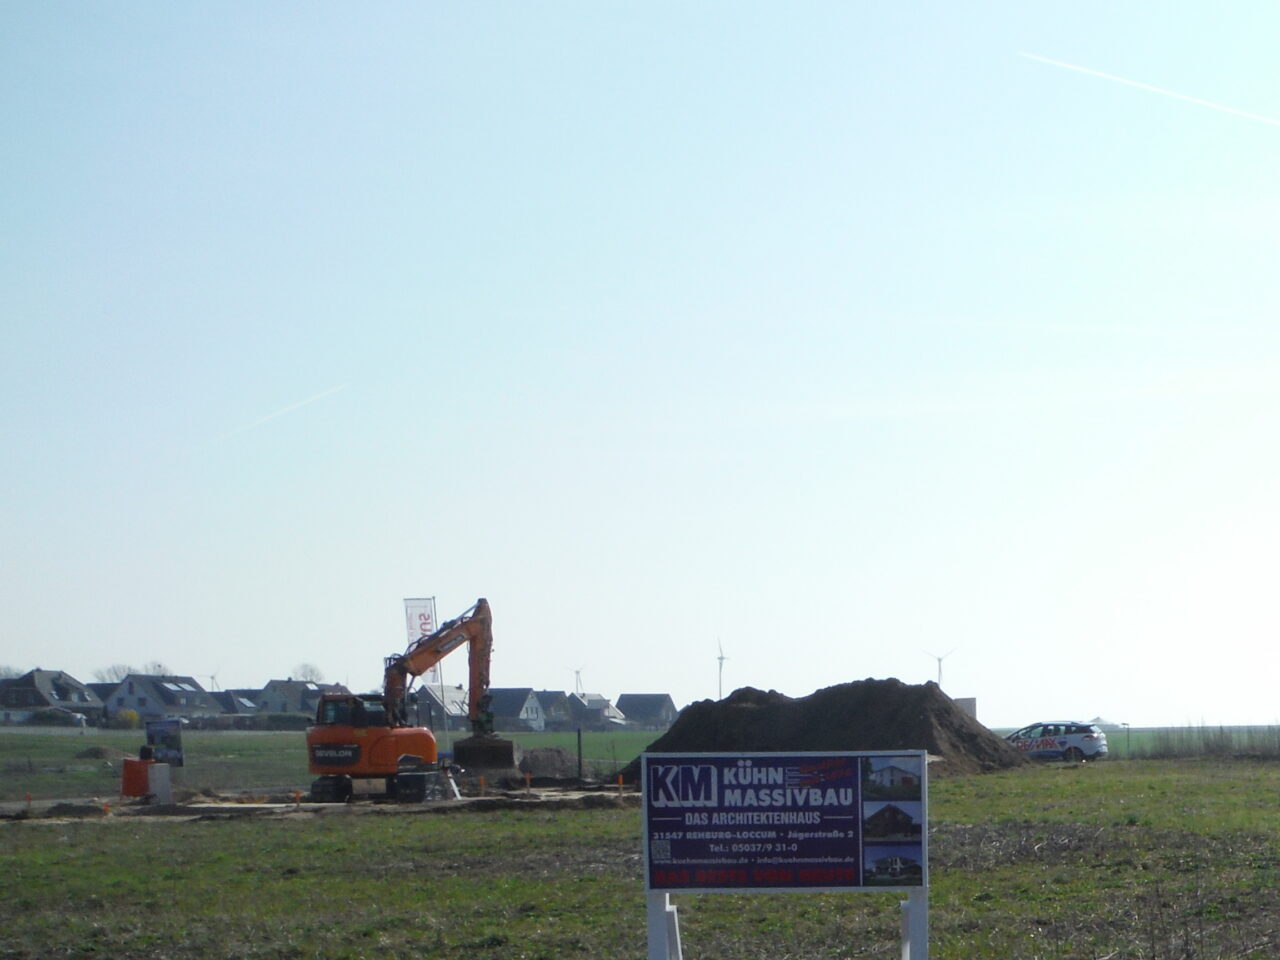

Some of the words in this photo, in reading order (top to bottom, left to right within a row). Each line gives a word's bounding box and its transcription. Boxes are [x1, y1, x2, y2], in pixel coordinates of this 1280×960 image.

[1016, 736, 1059, 752] RE/MAX
[722, 760, 784, 786] KÜHN
[651, 764, 719, 808] KM
[723, 788, 853, 807] MASSIVBAU
[685, 812, 709, 826] DAS
[712, 811, 821, 825] ARCHITEKTENHAUS
[653, 832, 684, 840] 31547
[686, 831, 777, 839] REHBURG-LOCCUM
[787, 829, 846, 840] Jägerstraße
[709, 844, 730, 853] Tel.:
[732, 842, 773, 853] 05037/9
[775, 843, 798, 852] 31-0
